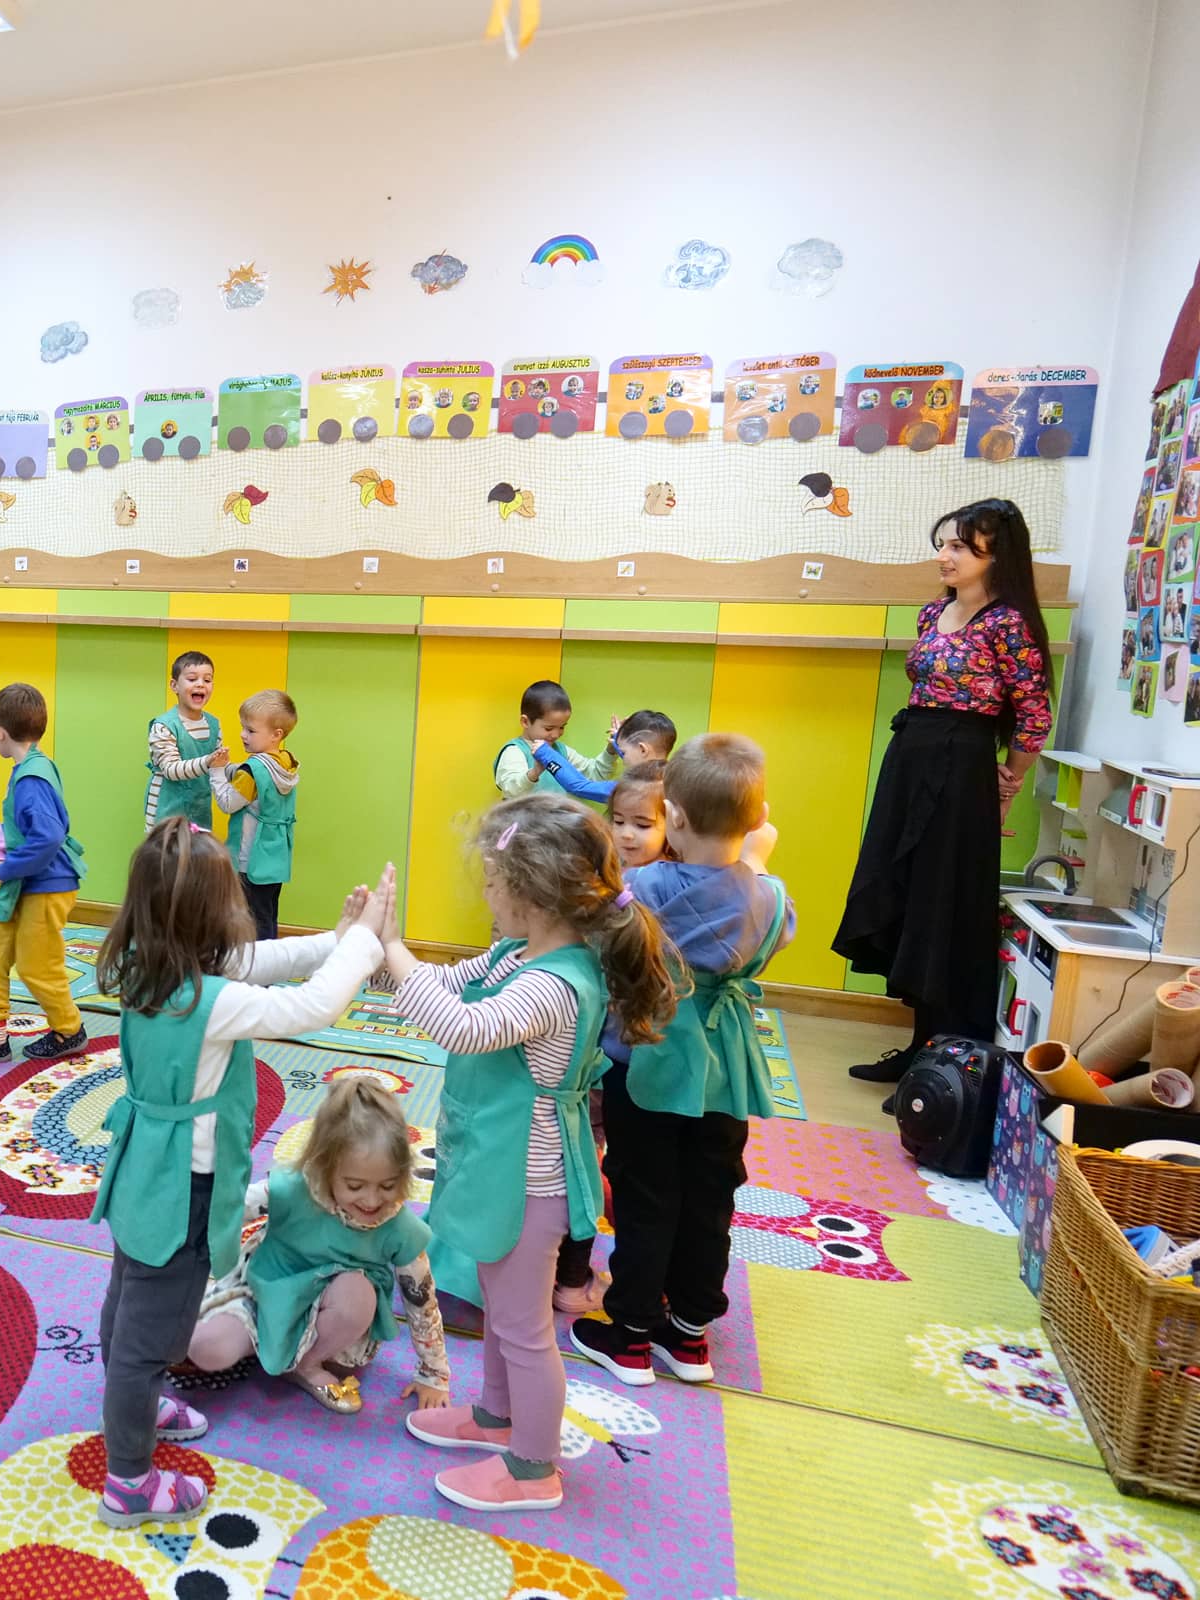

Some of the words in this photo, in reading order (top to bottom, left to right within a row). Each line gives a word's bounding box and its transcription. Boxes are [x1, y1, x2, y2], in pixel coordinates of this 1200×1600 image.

[551, 358, 590, 368] AUGUSZTUS
[359, 366, 384, 379] JÚNIUS
[900, 365, 945, 377] NOVEMBER
[987, 370, 1038, 383] deres-darás
[1040, 369, 1087, 382] DECEMBER
[94, 399, 121, 411] MÁRCIUS
